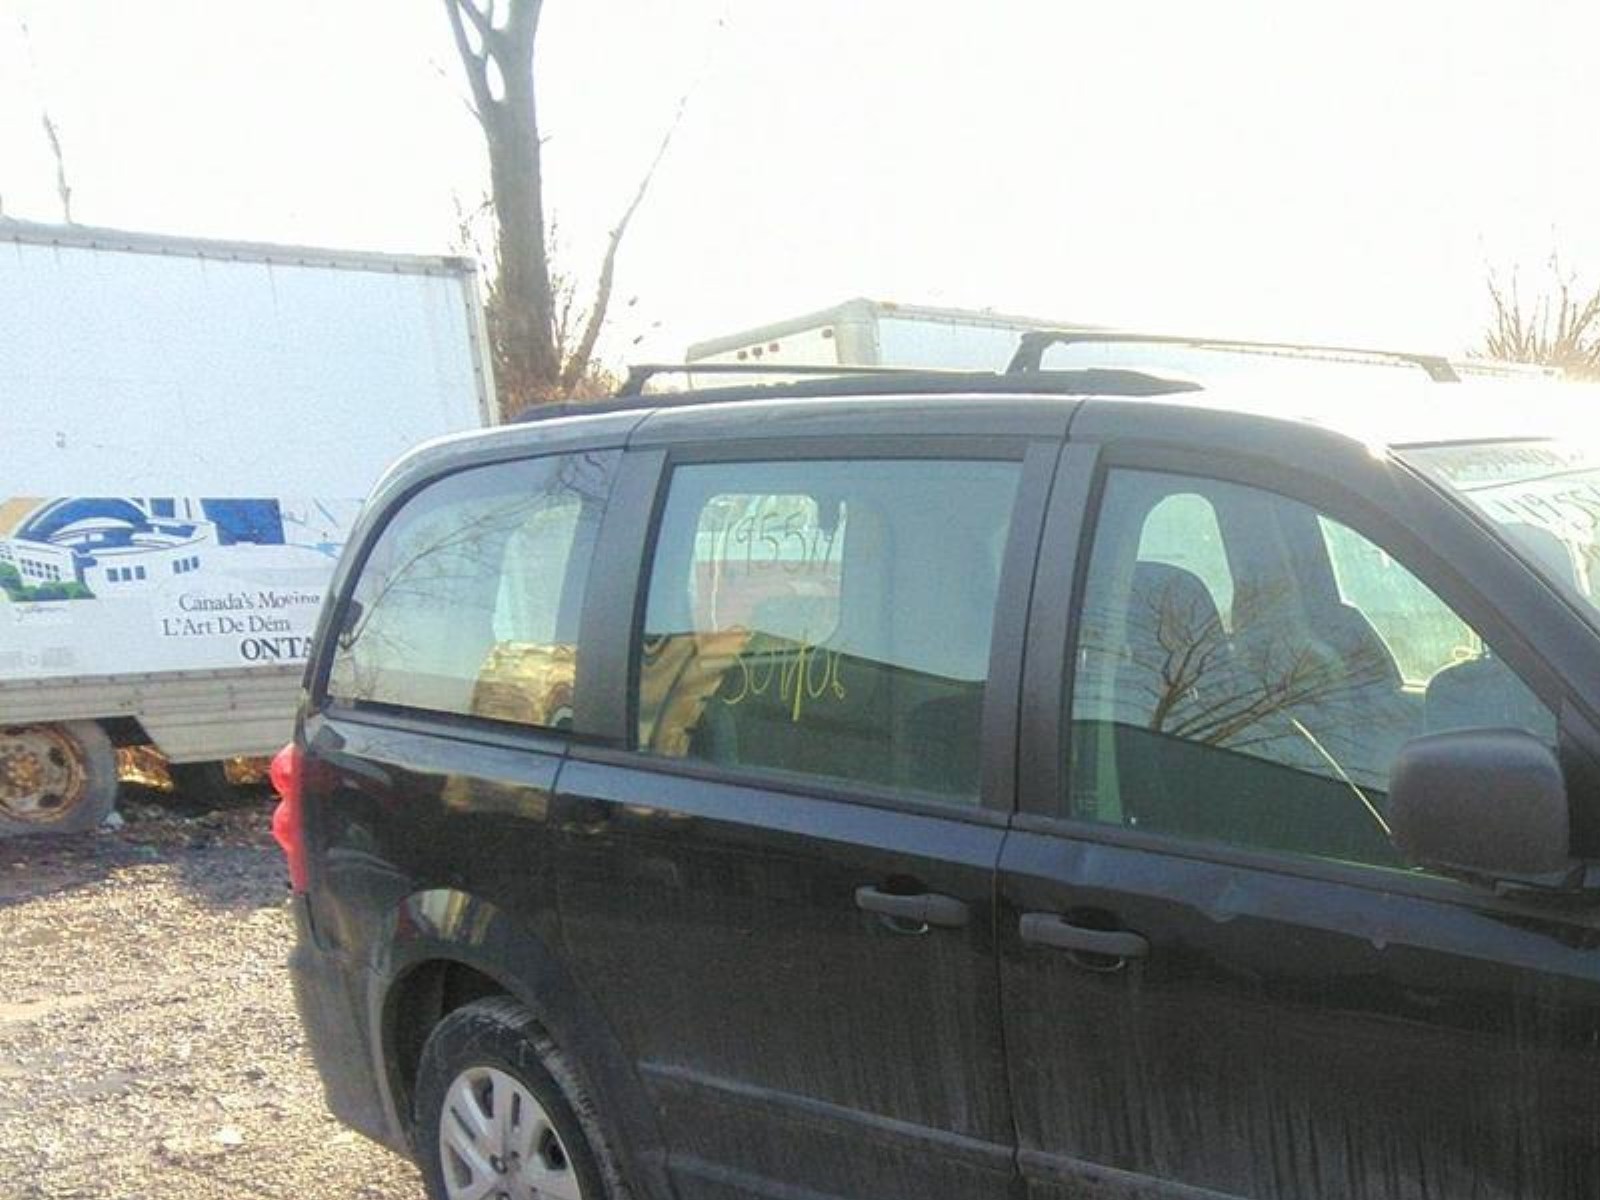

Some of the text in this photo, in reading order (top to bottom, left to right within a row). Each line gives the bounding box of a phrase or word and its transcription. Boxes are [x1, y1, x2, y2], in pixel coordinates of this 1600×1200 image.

[179, 592, 254, 612] Canada's
[163, 617, 212, 636] L'Art
[219, 617, 244, 634] De
